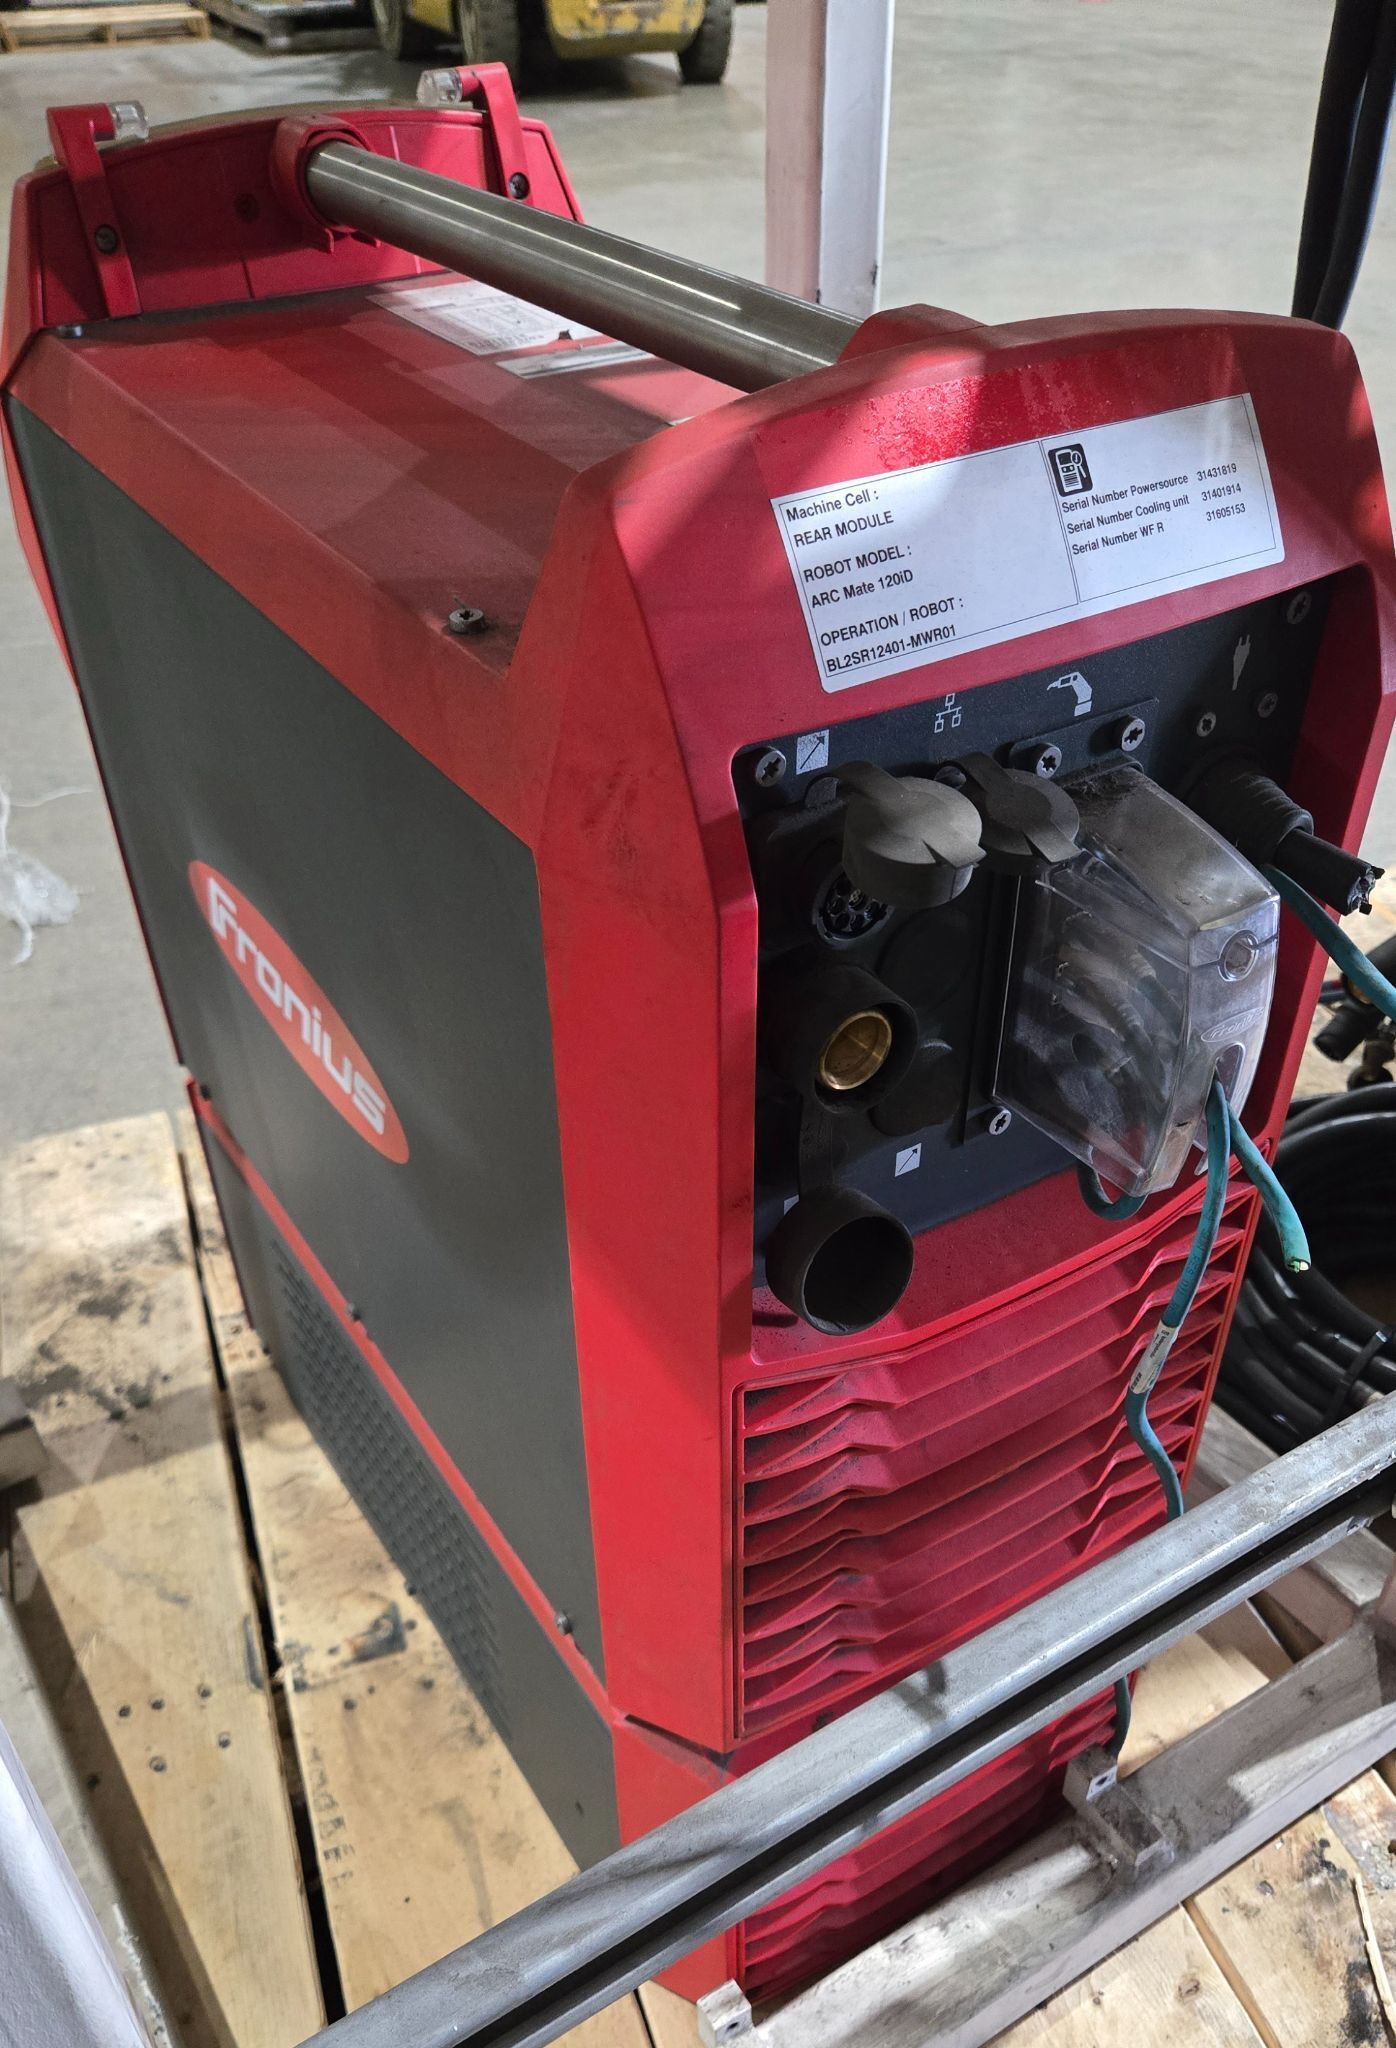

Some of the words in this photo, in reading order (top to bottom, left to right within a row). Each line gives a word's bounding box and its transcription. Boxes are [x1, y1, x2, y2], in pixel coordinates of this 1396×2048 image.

[786, 500, 842, 522] Machine
[845, 489, 871, 506] Cell
[1062, 499, 1089, 513] Serial
[1092, 489, 1128, 505] Number
[1130, 474, 1188, 496] Powersource
[1197, 463, 1237, 481] 31431819
[1067, 518, 1095, 534] Serial
[1097, 510, 1133, 526] Number
[1136, 500, 1171, 517] Cooling
[1173, 495, 1190, 508] unit
[1202, 483, 1241, 502] 31401914
[794, 527, 832, 547] REAR
[835, 510, 894, 537] MODULE
[1072, 539, 1099, 555] Serial
[1102, 529, 1137, 547] Number
[1140, 524, 1154, 537] WF
[1157, 522, 1164, 533] R
[1206, 504, 1246, 522] 31605153
[803, 559, 852, 583] ROBOT
[856, 545, 905, 567] MODEL
[811, 589, 840, 608] ARC
[843, 582, 875, 600] Mate
[878, 569, 913, 590] 120iD
[820, 614, 899, 646] OPERATION
[902, 611, 906, 625] /
[910, 597, 955, 621] ROBOT
[826, 624, 956, 672] BL2SR12401-MWR01
[207, 877, 386, 1135] Fronius
